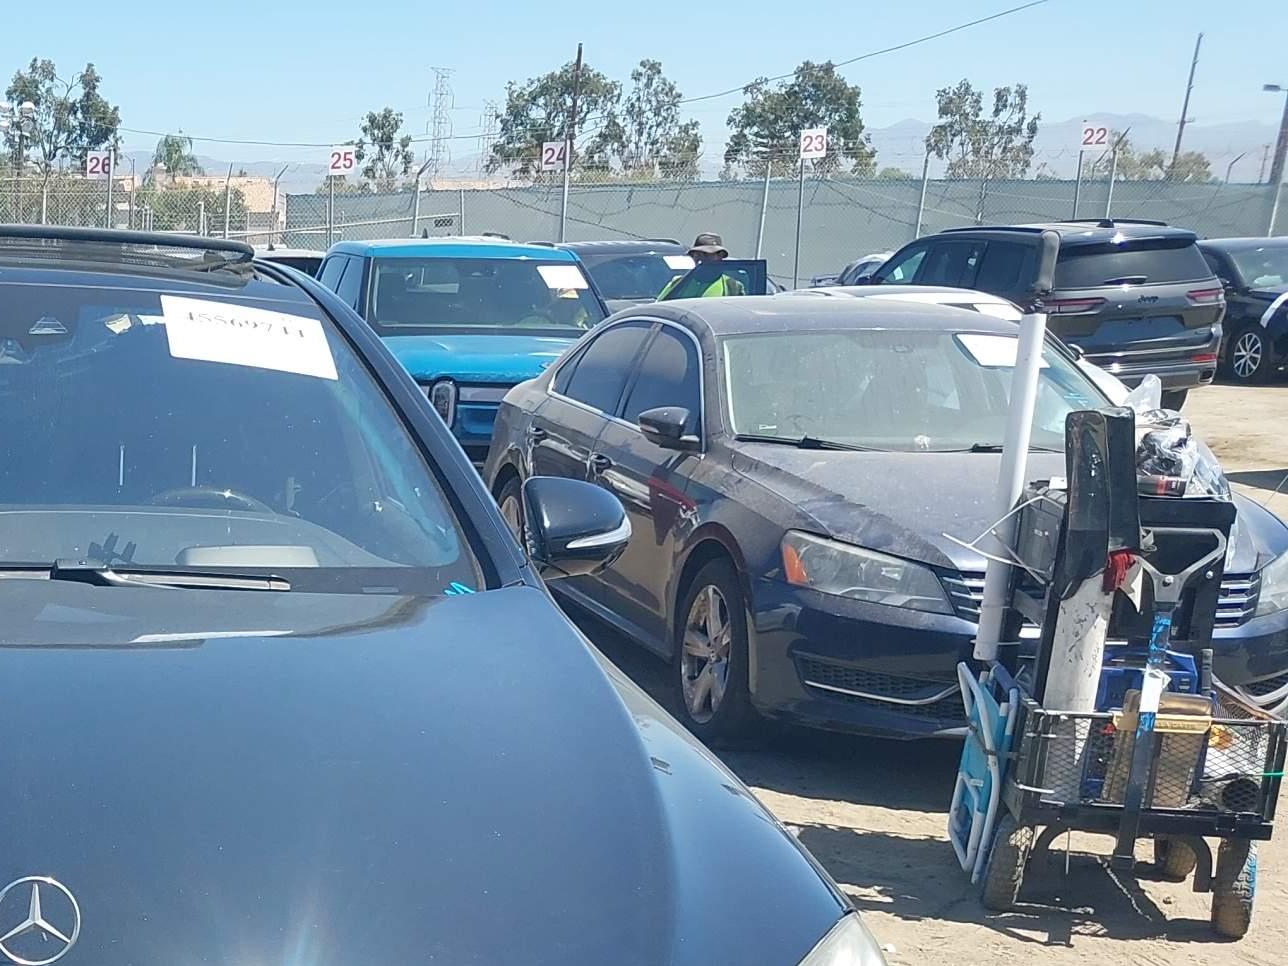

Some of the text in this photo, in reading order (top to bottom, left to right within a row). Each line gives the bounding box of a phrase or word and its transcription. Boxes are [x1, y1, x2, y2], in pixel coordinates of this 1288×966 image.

[802, 134, 825, 152] 23
[1082, 127, 1108, 145] 22
[330, 151, 354, 169] 25
[544, 146, 566, 165] 24
[89, 156, 110, 174] 26
